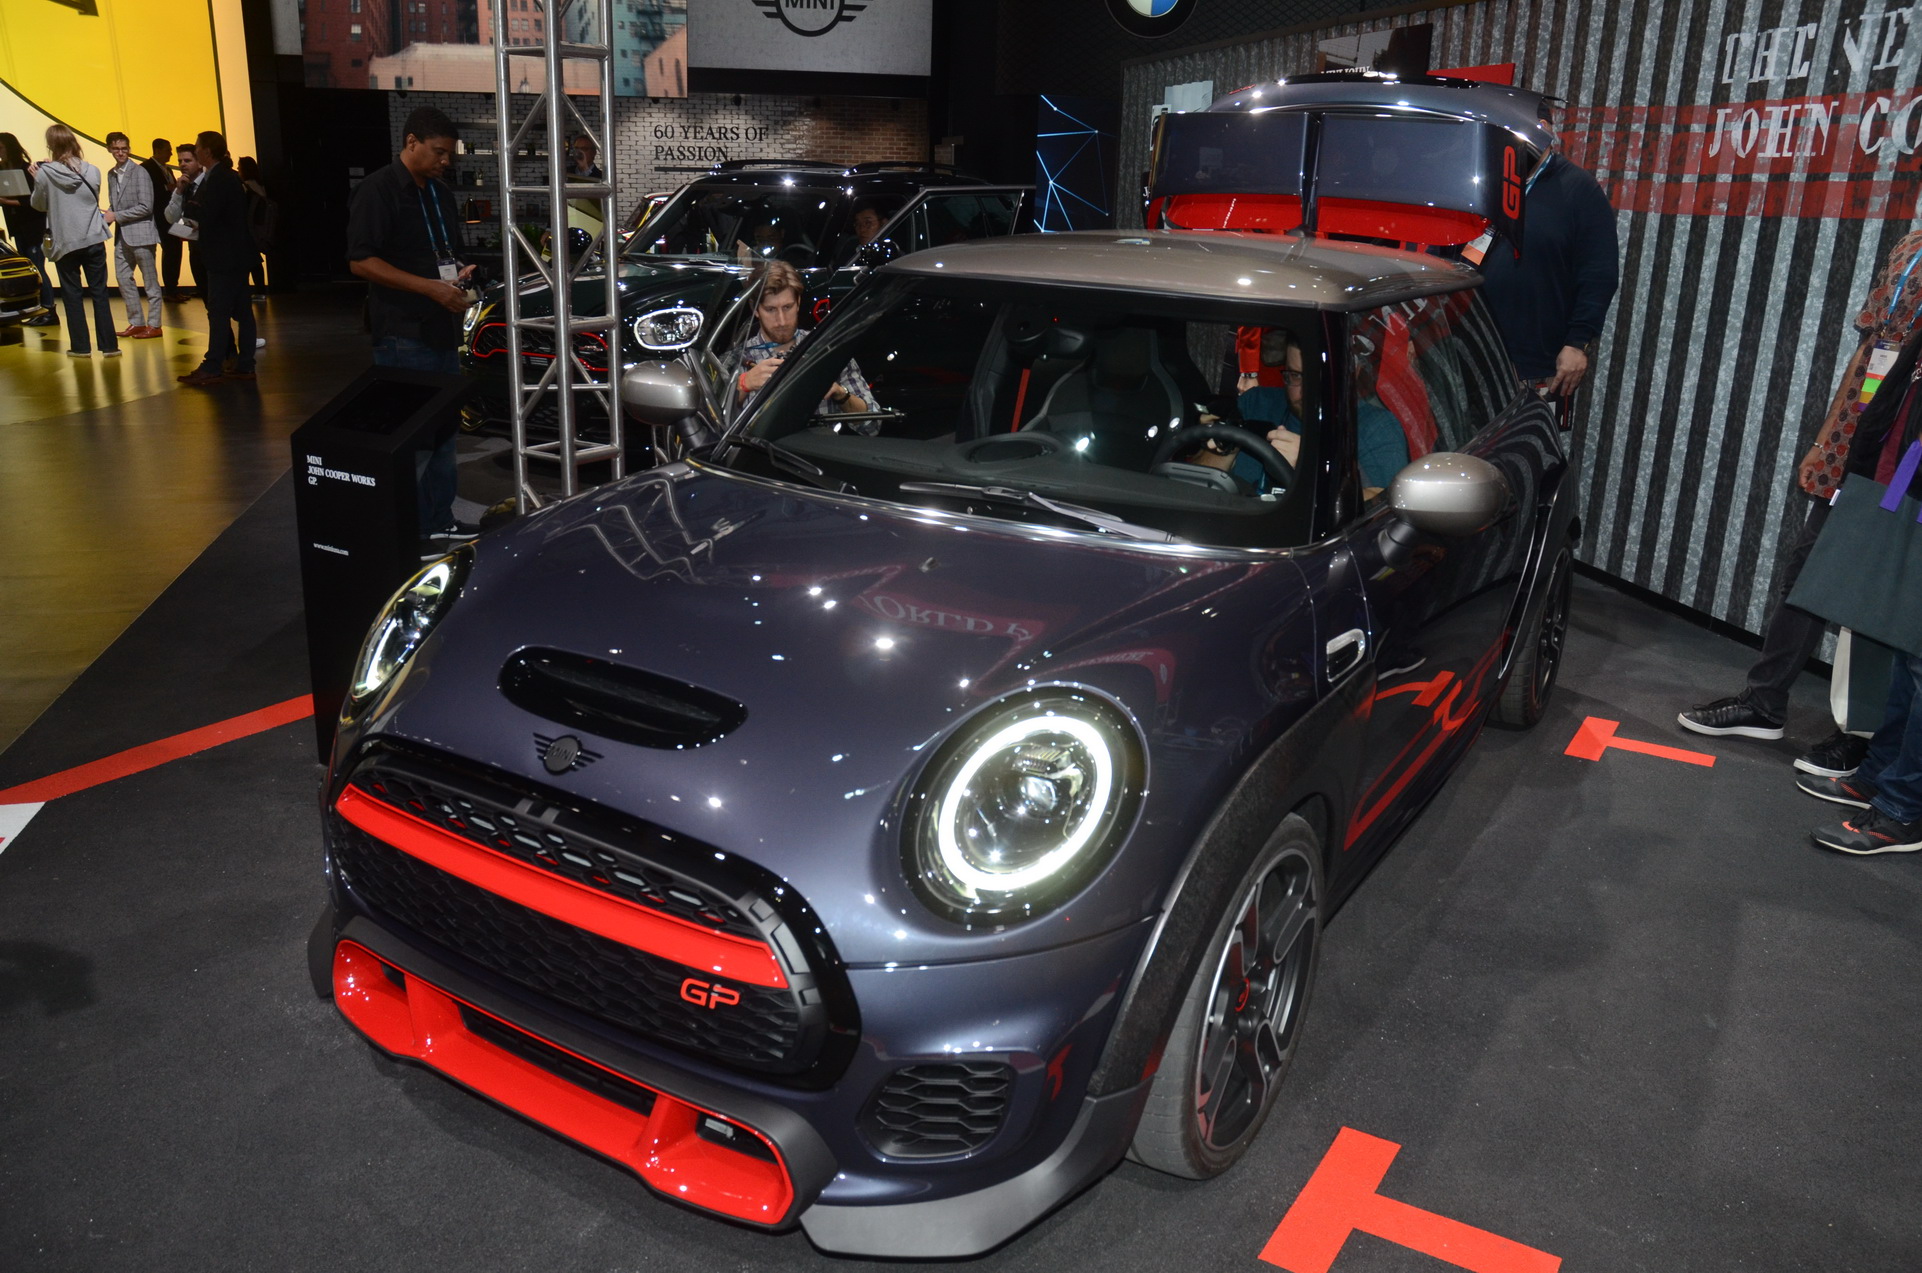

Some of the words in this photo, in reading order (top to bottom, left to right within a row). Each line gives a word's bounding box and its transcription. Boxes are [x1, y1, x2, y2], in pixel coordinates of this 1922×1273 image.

[785, 0, 835, 9] MINI
[653, 124, 675, 139] 60
[680, 125, 740, 140] YEARS
[744, 126, 769, 141] OF
[1709, 102, 1839, 158] JOHN
[653, 145, 733, 161] PASSION.
[1503, 145, 1520, 219] GP
[306, 455, 322, 465] MINI
[307, 466, 325, 476] JOHN
[325, 469, 350, 481] COOPER
[351, 474, 376, 486] WORKS
[680, 977, 740, 1010] GP
